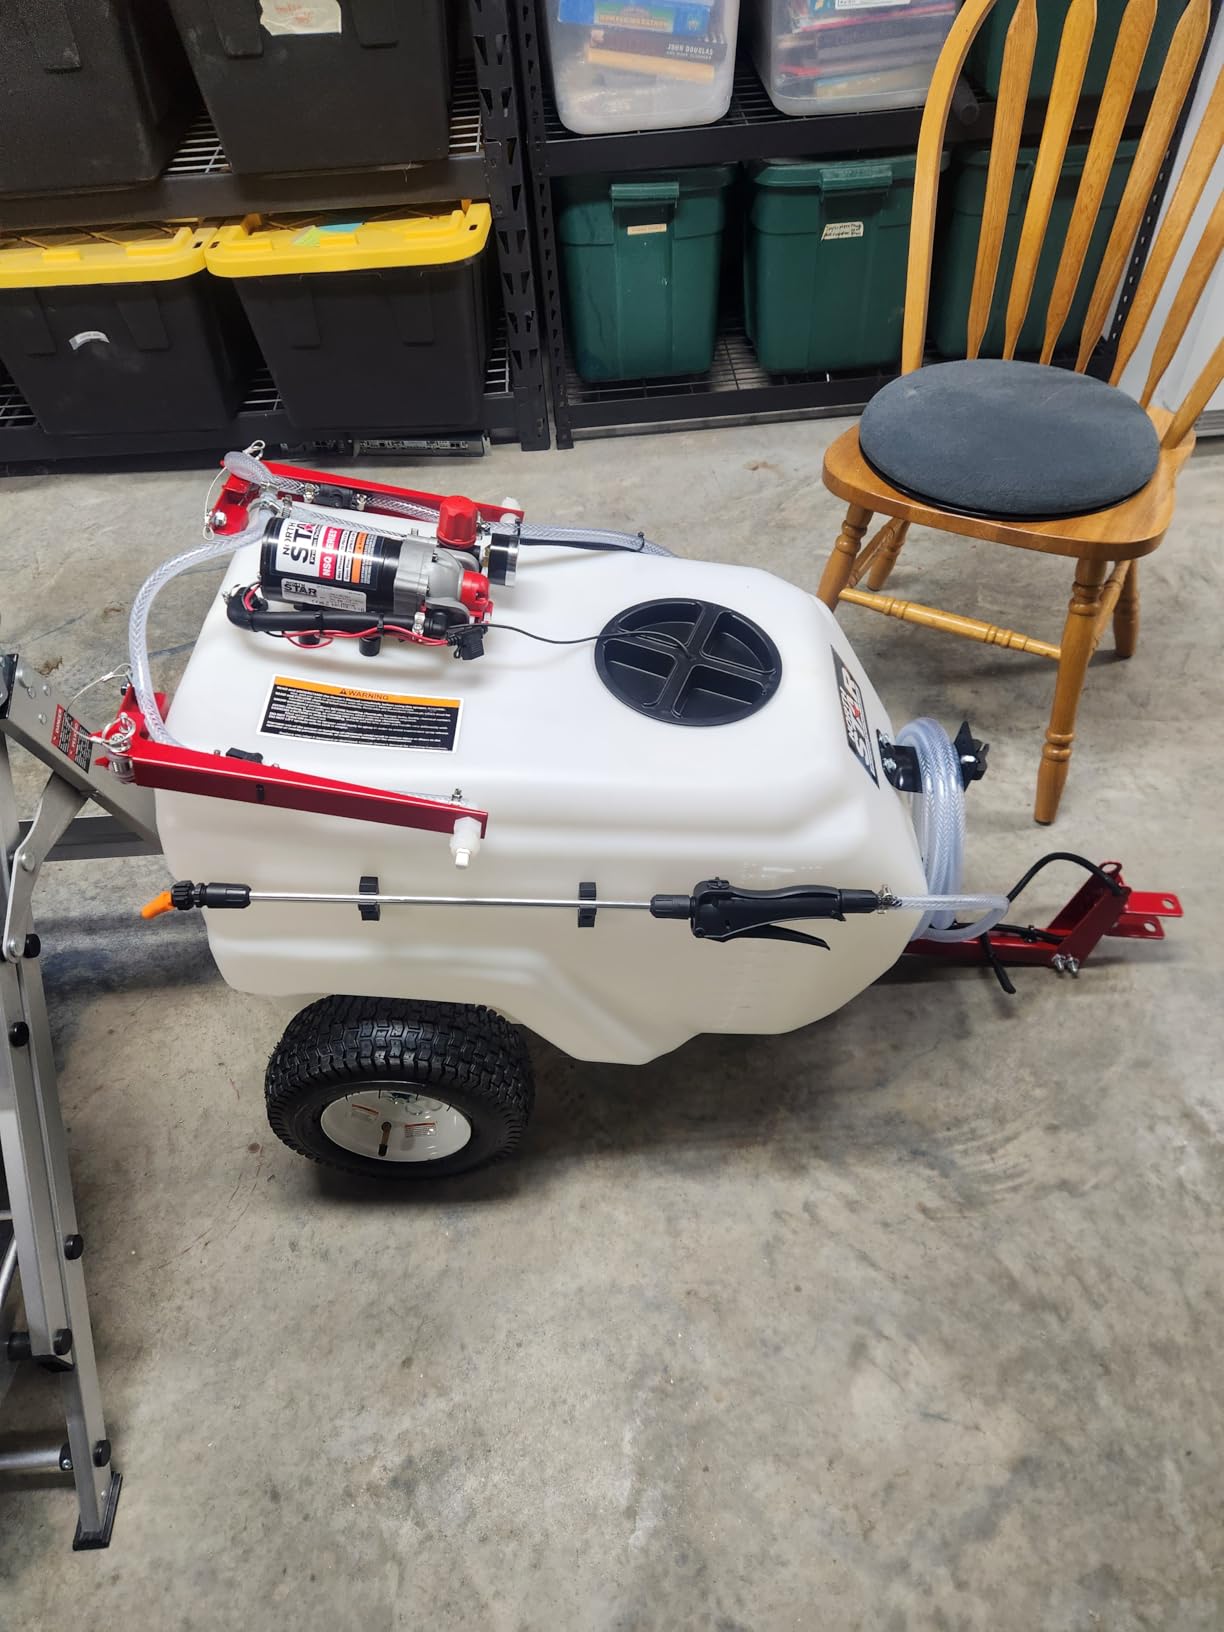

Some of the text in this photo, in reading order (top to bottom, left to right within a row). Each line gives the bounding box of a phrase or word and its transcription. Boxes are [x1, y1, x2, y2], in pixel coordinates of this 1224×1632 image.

[667, 43, 683, 52] JOHN
[685, 46, 713, 56] DOUGLAS
[282, 522, 296, 556] NORTH
[290, 522, 315, 564] STA
[322, 528, 338, 577] NSQ ERIES
[284, 583, 318, 596] STAR
[348, 689, 389, 701] WARNING
[841, 666, 870, 767] STAR
